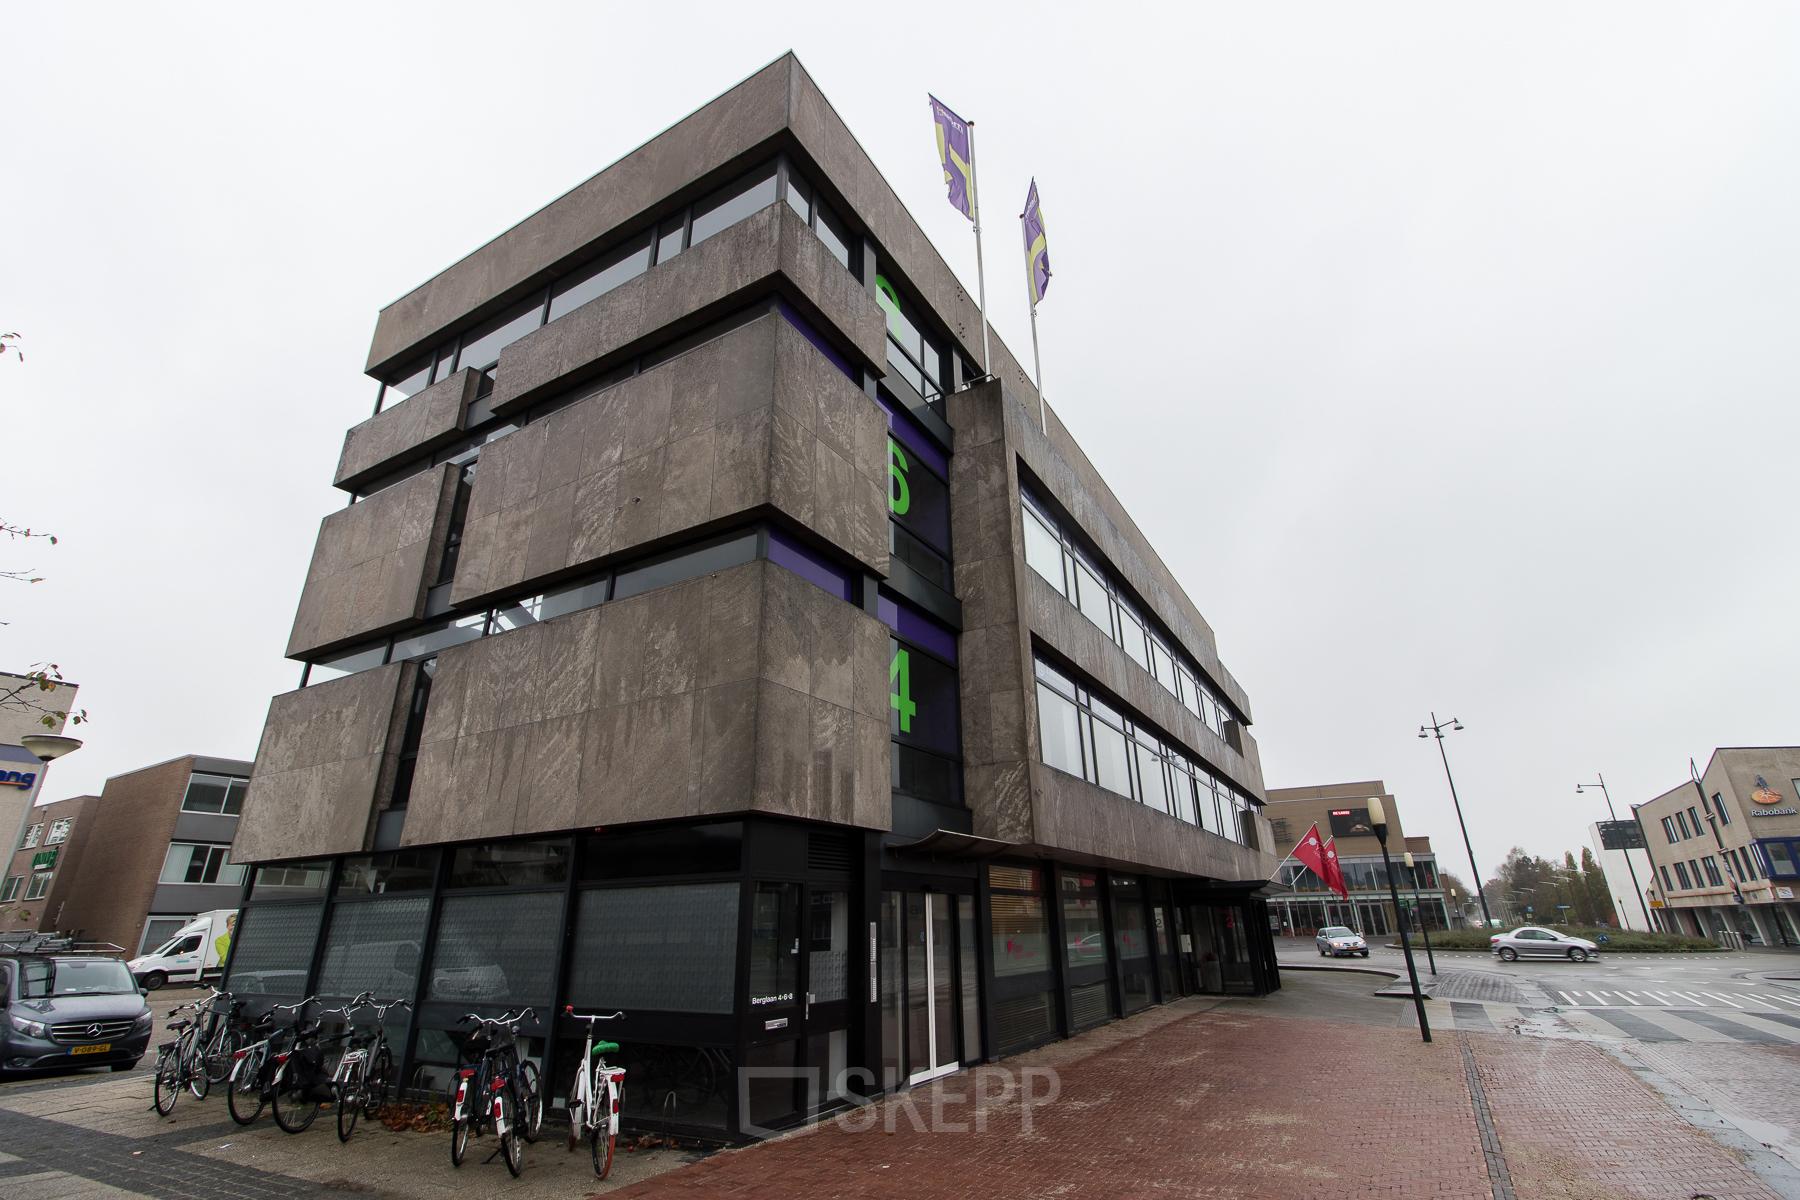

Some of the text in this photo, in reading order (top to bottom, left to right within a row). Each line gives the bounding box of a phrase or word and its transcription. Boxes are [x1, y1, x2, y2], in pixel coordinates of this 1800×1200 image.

[888, 438, 910, 515] 6
[890, 648, 916, 733] 4
[1751, 807, 1798, 816] Rabobank
[752, 996, 777, 1005] Berglaan
